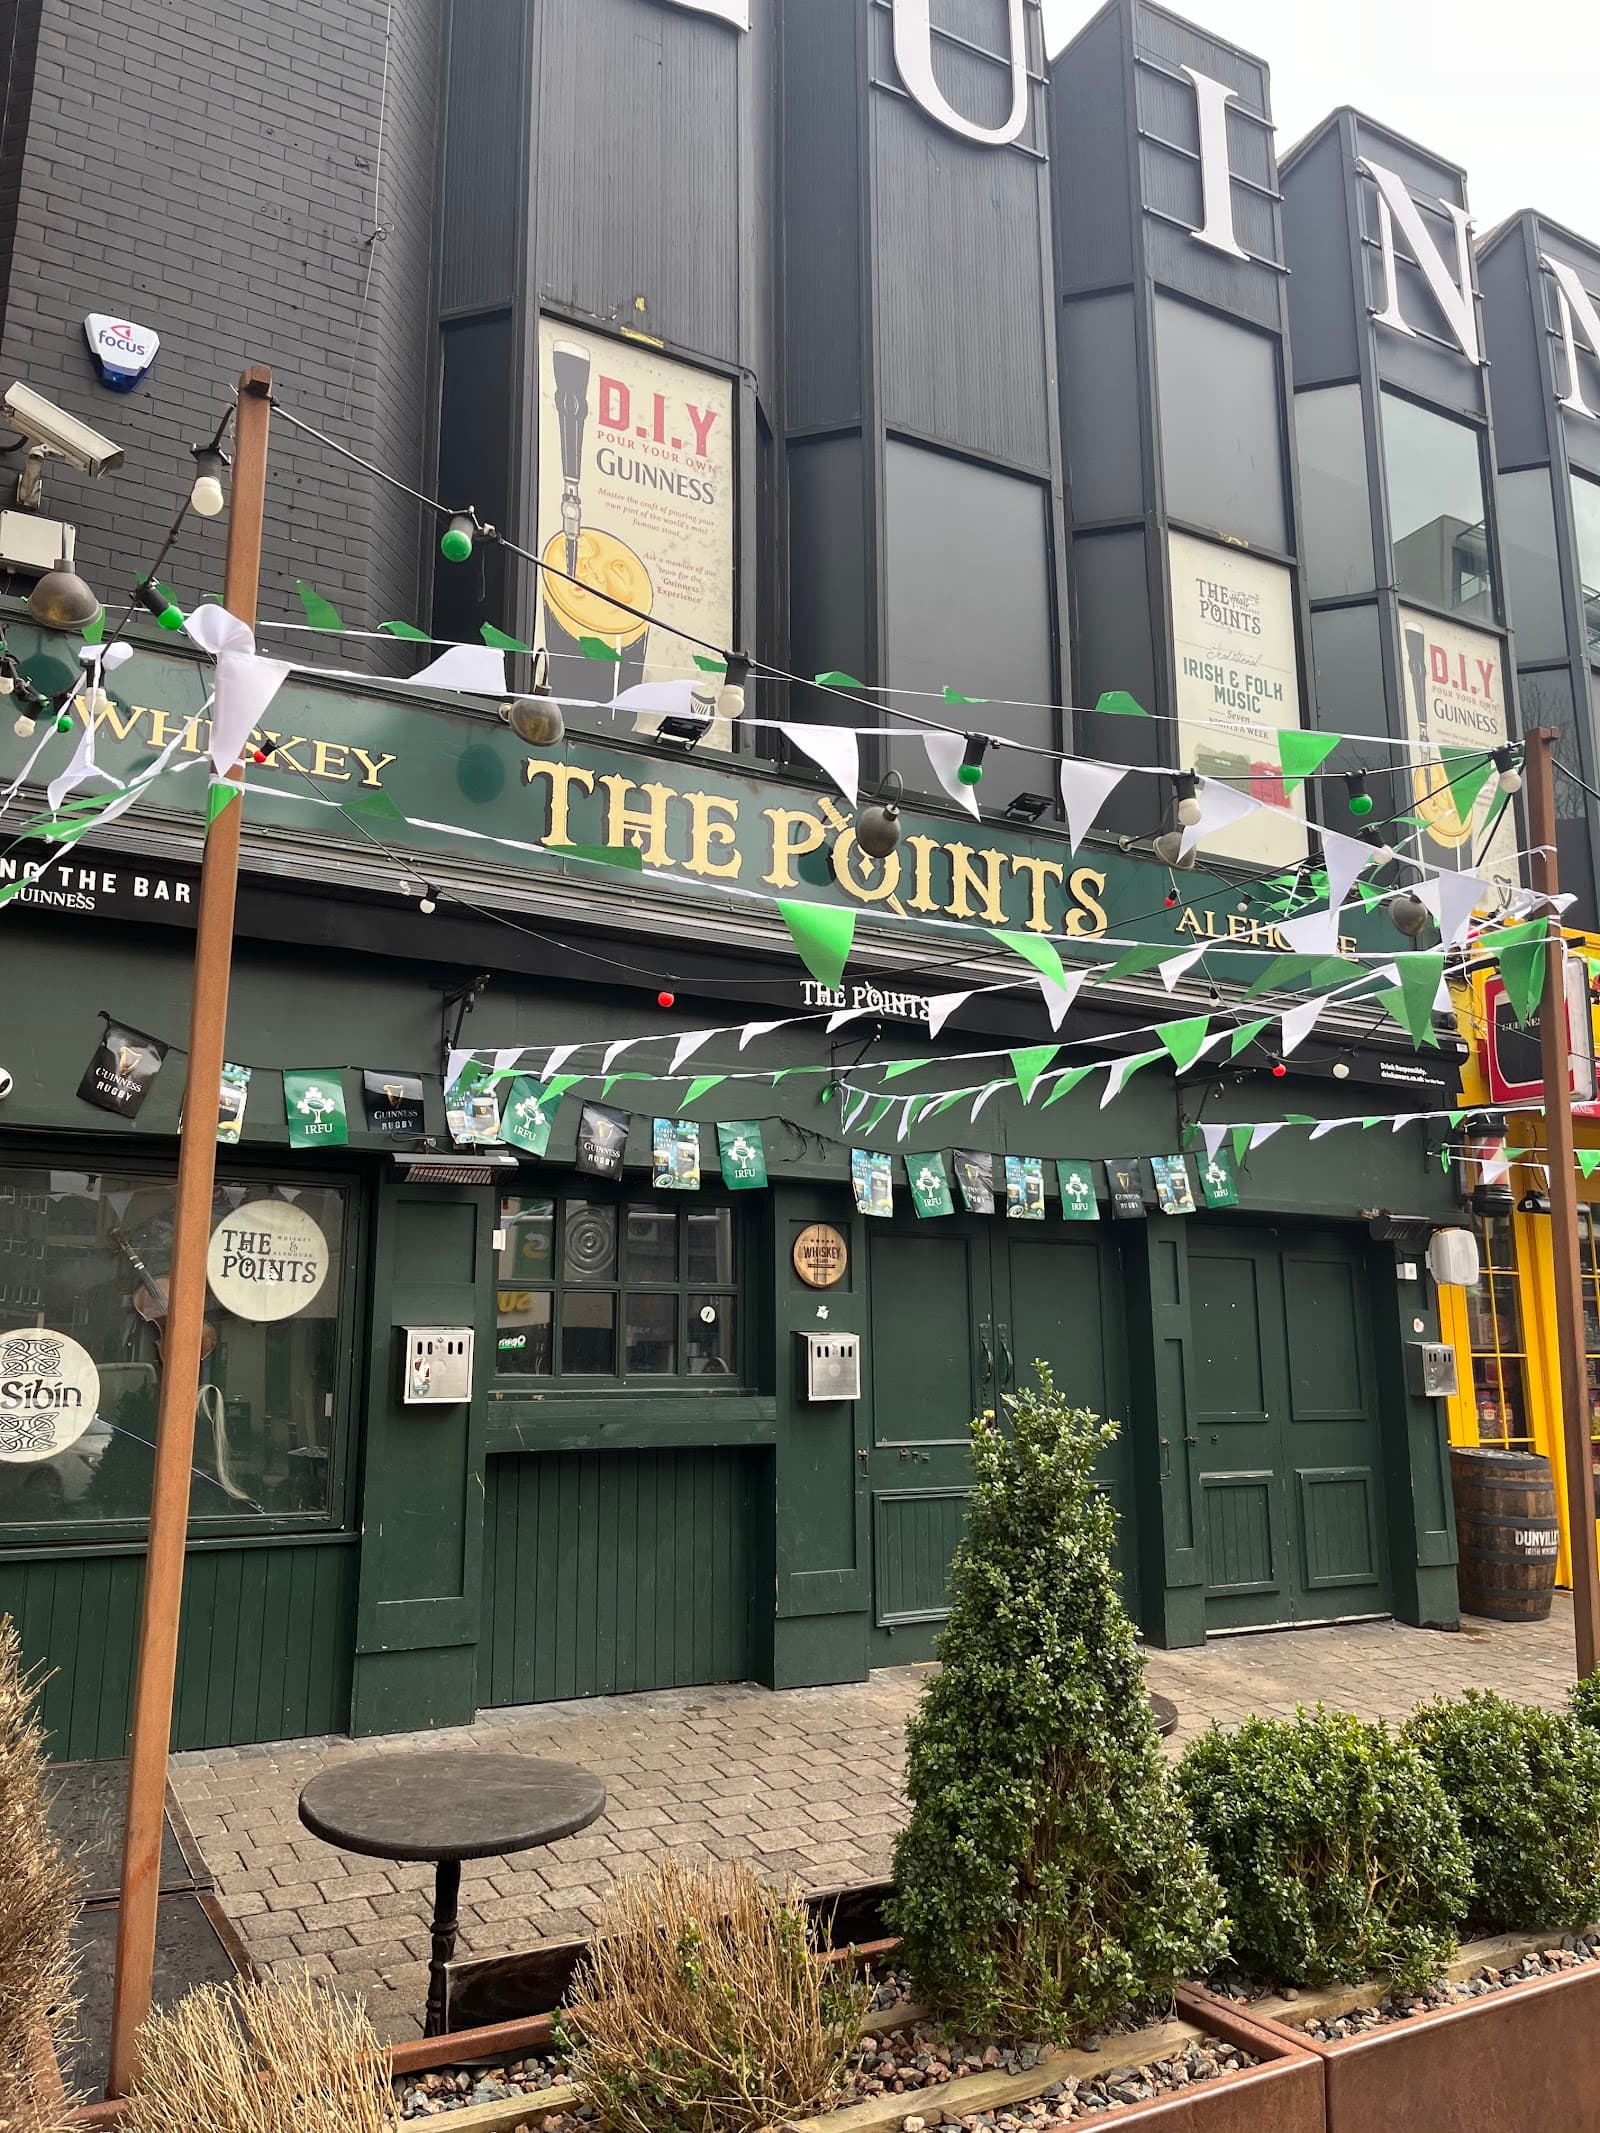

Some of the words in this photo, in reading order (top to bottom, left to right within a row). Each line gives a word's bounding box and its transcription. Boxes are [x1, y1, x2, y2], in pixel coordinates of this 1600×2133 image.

[99, 330, 145, 355] focus
[598, 374, 718, 457] D.I.Y
[598, 430, 635, 449] POUR
[643, 443, 679, 463] YOUR
[686, 458, 718, 474] OWN
[596, 447, 714, 505] GUINNESS
[598, 488, 625, 501] Master
[627, 495, 639, 505] the
[640, 500, 658, 511] craft
[660, 505, 668, 513] of
[668, 509, 697, 522] pouring
[605, 502, 621, 511] own
[623, 505, 639, 515] pint
[650, 512, 661, 521] the
[633, 519, 659, 531] famous
[1196, 578, 1229, 605] THE
[1200, 598, 1261, 635] POINTS
[1184, 657, 1224, 685] IRISH
[1430, 644, 1494, 699] D.I.Y
[1214, 685, 1261, 714] MUSIC
[1227, 711, 1250, 723] Seven
[1434, 698, 1498, 735] GUINNESS
[73, 694, 397, 787] WHSKEY
[1246, 726, 1269, 739] WEEK
[527, 756, 742, 879] THE
[762, 797, 1107, 938] POINTS
[58, 866, 117, 893] THE
[133, 876, 191, 903] BAR
[1176, 907, 1359, 962] ALEHOE
[800, 981, 846, 1008] THE
[852, 981, 930, 1021] POINTS
[95, 1066, 142, 1093] GUINNESS
[96, 1081, 132, 1102] RUGBY
[374, 1110, 418, 1120] GUINNESS
[381, 1120, 414, 1131] RUGBY
[304, 1123, 333, 1135] IRFU
[513, 1124, 537, 1141] IRFU
[584, 1141, 621, 1158] GUINNESS
[588, 1154, 615, 1167] RUGBY
[734, 1168, 757, 1180] IRFU
[923, 1197, 942, 1208] IRFU
[222, 1229, 271, 1255] THE
[803, 1245, 841, 1260] WHISKEY
[220, 1252, 317, 1283] POINTS
